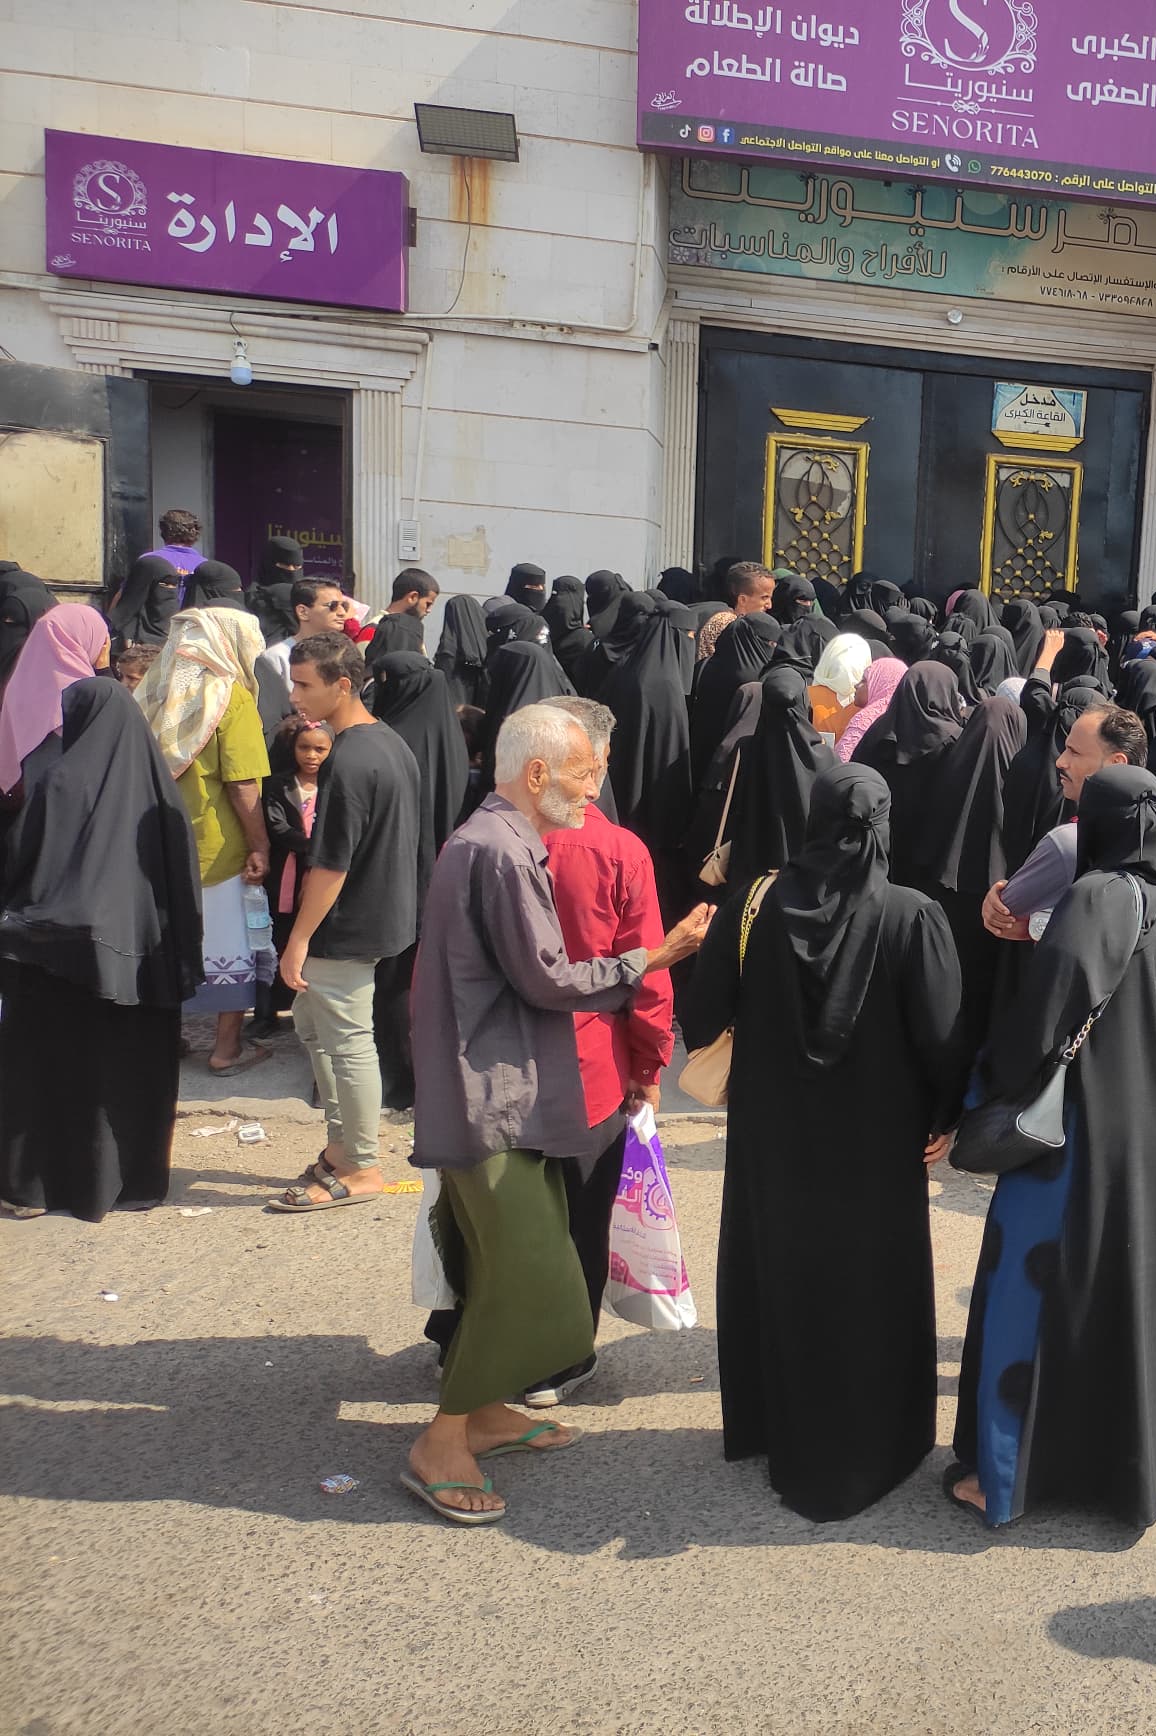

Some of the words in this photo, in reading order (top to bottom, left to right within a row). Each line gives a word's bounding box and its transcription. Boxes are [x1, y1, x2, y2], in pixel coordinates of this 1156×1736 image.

[684, 0, 782, 39] الإطلالة
[791, 14, 860, 49] ديوان
[685, 50, 781, 83] الطعام
[789, 60, 847, 92] صالة
[904, 63, 1033, 103] سنيوريتا
[1066, 78, 1156, 108] الصغرى
[891, 110, 1039, 149] SENORITA
[787, 139, 822, 154] التواصل
[853, 149, 873, 160] على
[874, 150, 894, 162] معنا
[895, 153, 929, 167] التواصل
[990, 165, 1052, 182] 776443070
[1060, 173, 1091, 188] الرقم
[1092, 177, 1115, 190] على
[165, 191, 339, 263] الإدارة
[71, 232, 152, 252] SENORITA
[668, 222, 855, 274] والمناسبات
[861, 240, 947, 279] للأفراح
[1042, 268, 1065, 279] على
[1019, 392, 1056, 407] مدخل
[1004, 408, 1035, 420] الكبرى
[1036, 410, 1066, 422] القاعة
